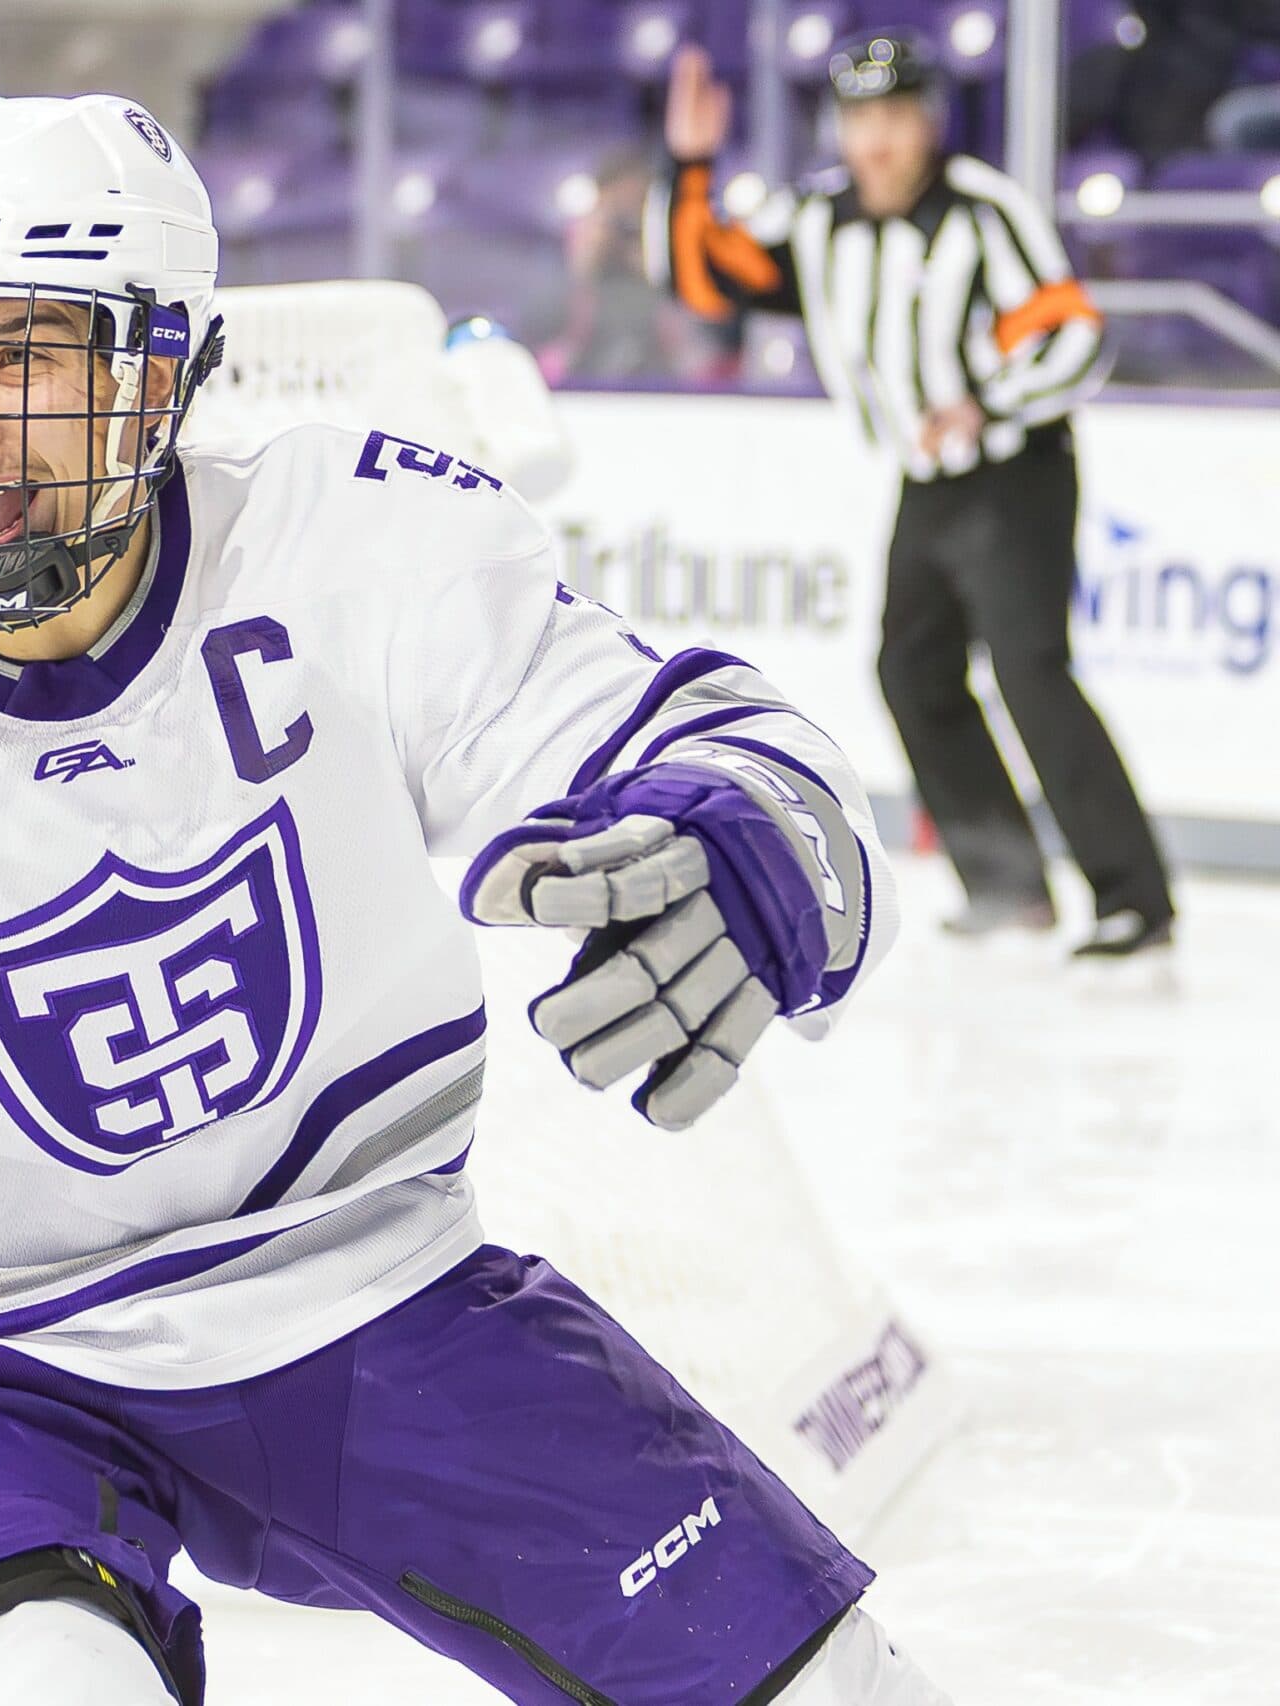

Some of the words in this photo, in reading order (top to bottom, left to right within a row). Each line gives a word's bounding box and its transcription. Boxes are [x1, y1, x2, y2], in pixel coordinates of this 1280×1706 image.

[152, 326, 187, 342] CCM
[558, 516, 850, 630] Tribune
[201, 615, 315, 785] C
[619, 1495, 722, 1598] CCM
